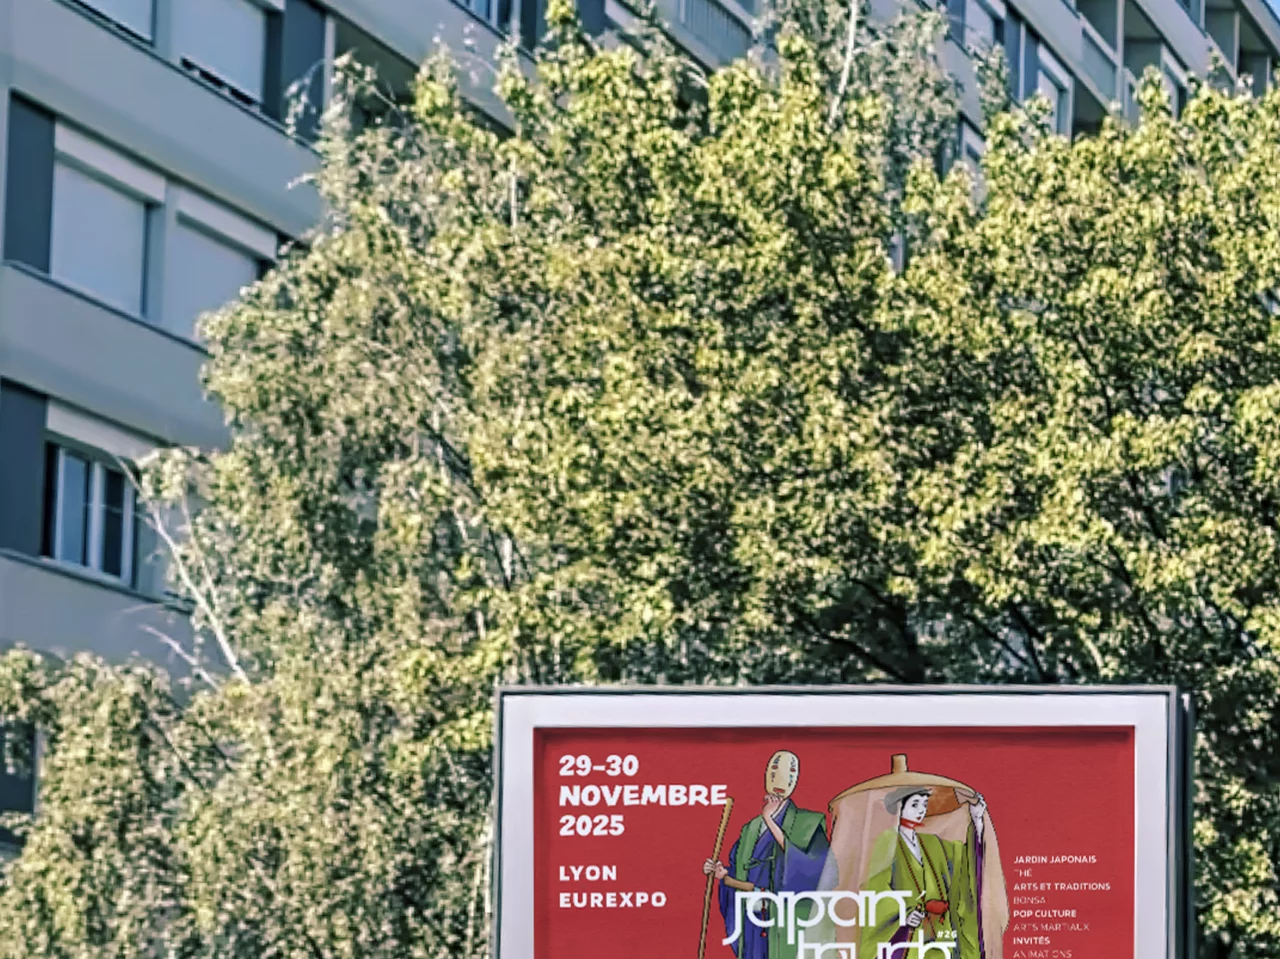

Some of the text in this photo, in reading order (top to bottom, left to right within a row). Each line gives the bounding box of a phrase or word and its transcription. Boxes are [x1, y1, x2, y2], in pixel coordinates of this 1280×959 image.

[559, 754, 639, 777] 29-30
[559, 784, 728, 807] NOVEMBRE
[559, 814, 625, 836] 2025
[1013, 855, 1097, 864] JARDIN JAPONAIS
[559, 865, 617, 881] LYON
[1013, 882, 1111, 891] ARTS ET TRADITIONS
[559, 891, 667, 908] EUREXPO
[722, 890, 914, 945] japan
[1013, 909, 1077, 918] POP CULTURE
[936, 929, 957, 938] #26
[1013, 935, 1051, 945] INVITÉS
